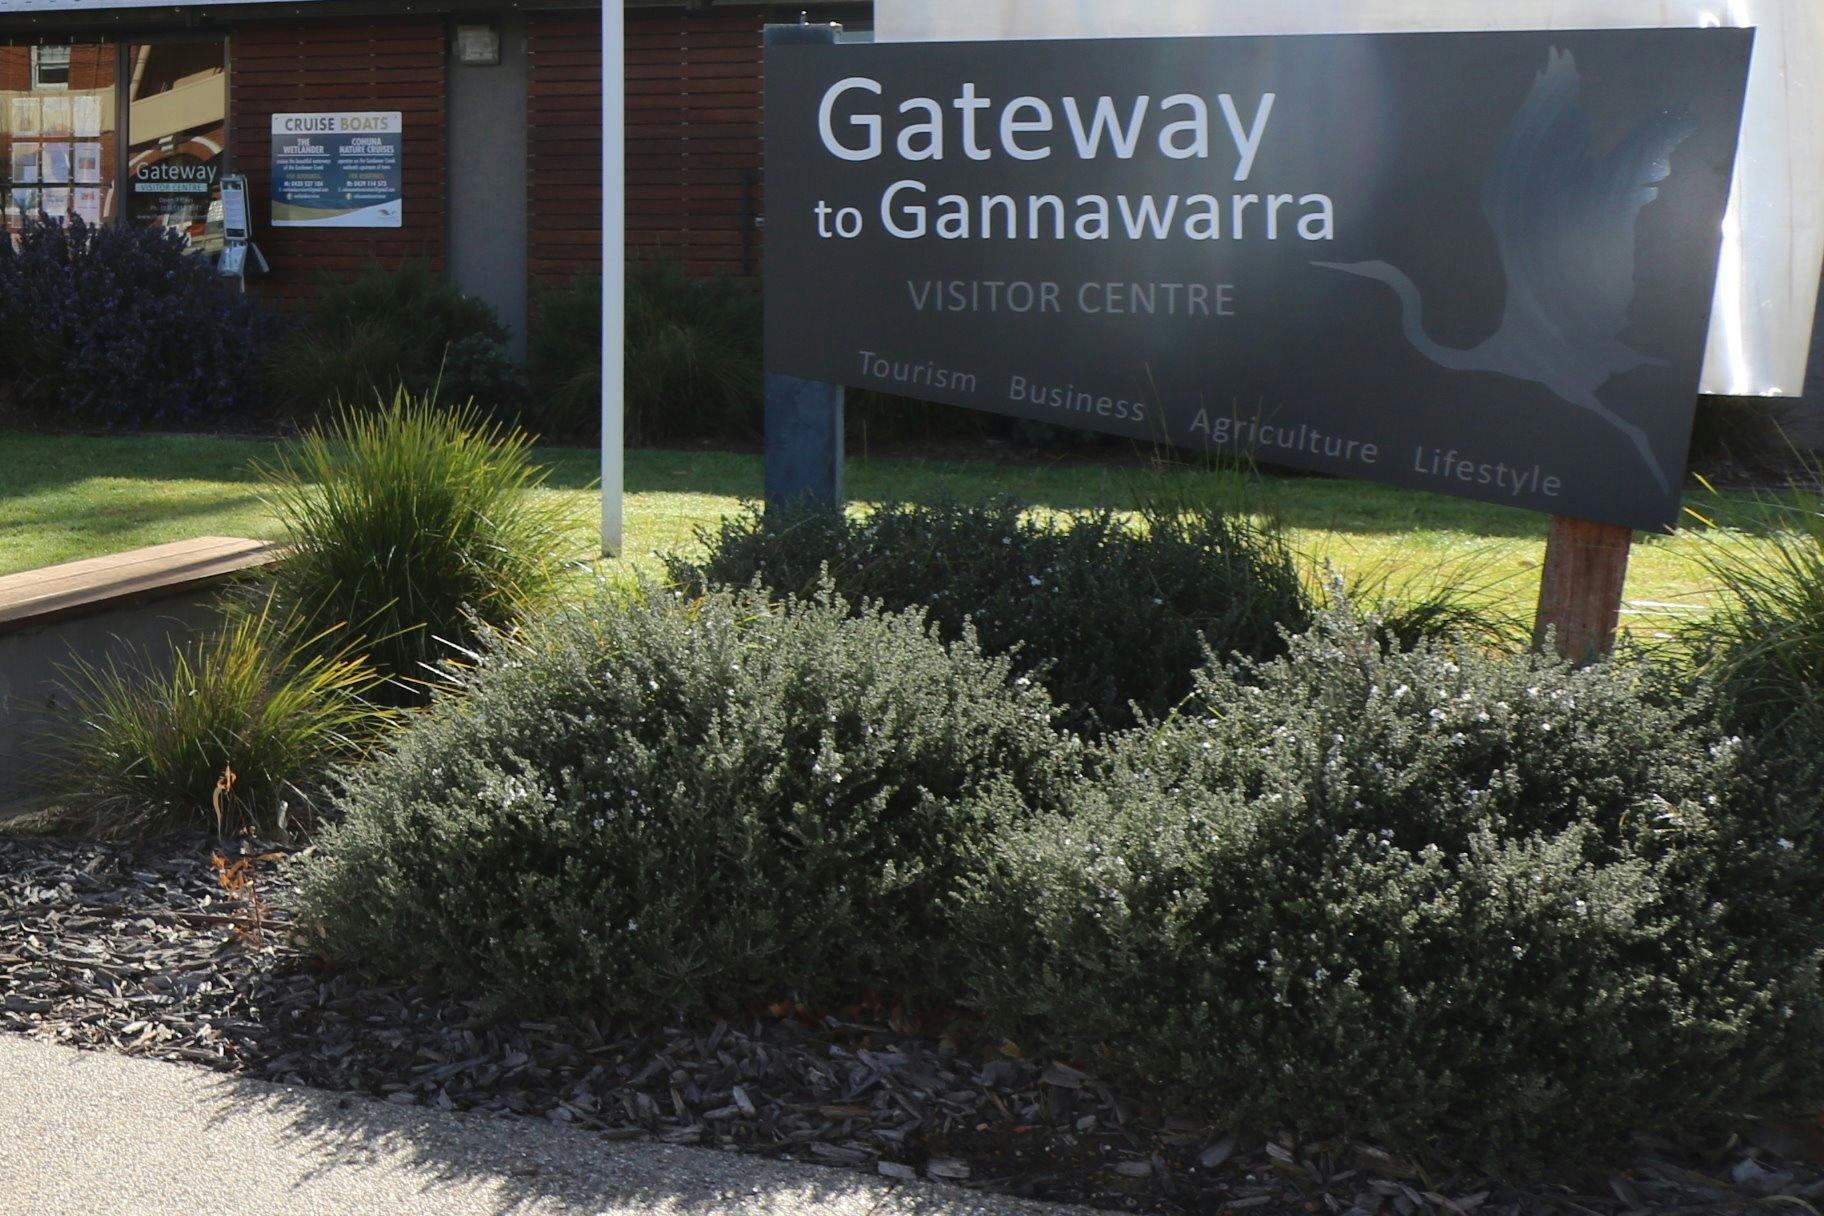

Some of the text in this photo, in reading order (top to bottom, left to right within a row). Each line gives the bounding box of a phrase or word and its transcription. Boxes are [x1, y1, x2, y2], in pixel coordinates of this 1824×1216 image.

[285, 116, 389, 132] CRUISE BOATS
[817, 76, 1277, 183] Gateway
[297, 138, 310, 146] THE
[339, 145, 395, 154] NATURE CRUISES
[351, 137, 383, 146] COHUNA
[136, 162, 217, 184] Gateway
[814, 179, 1335, 241] to Gannawarra
[907, 280, 1236, 317] VISITOR CENTRE
[858, 349, 1563, 499] Tourism Business Agriculture Lifestyle
